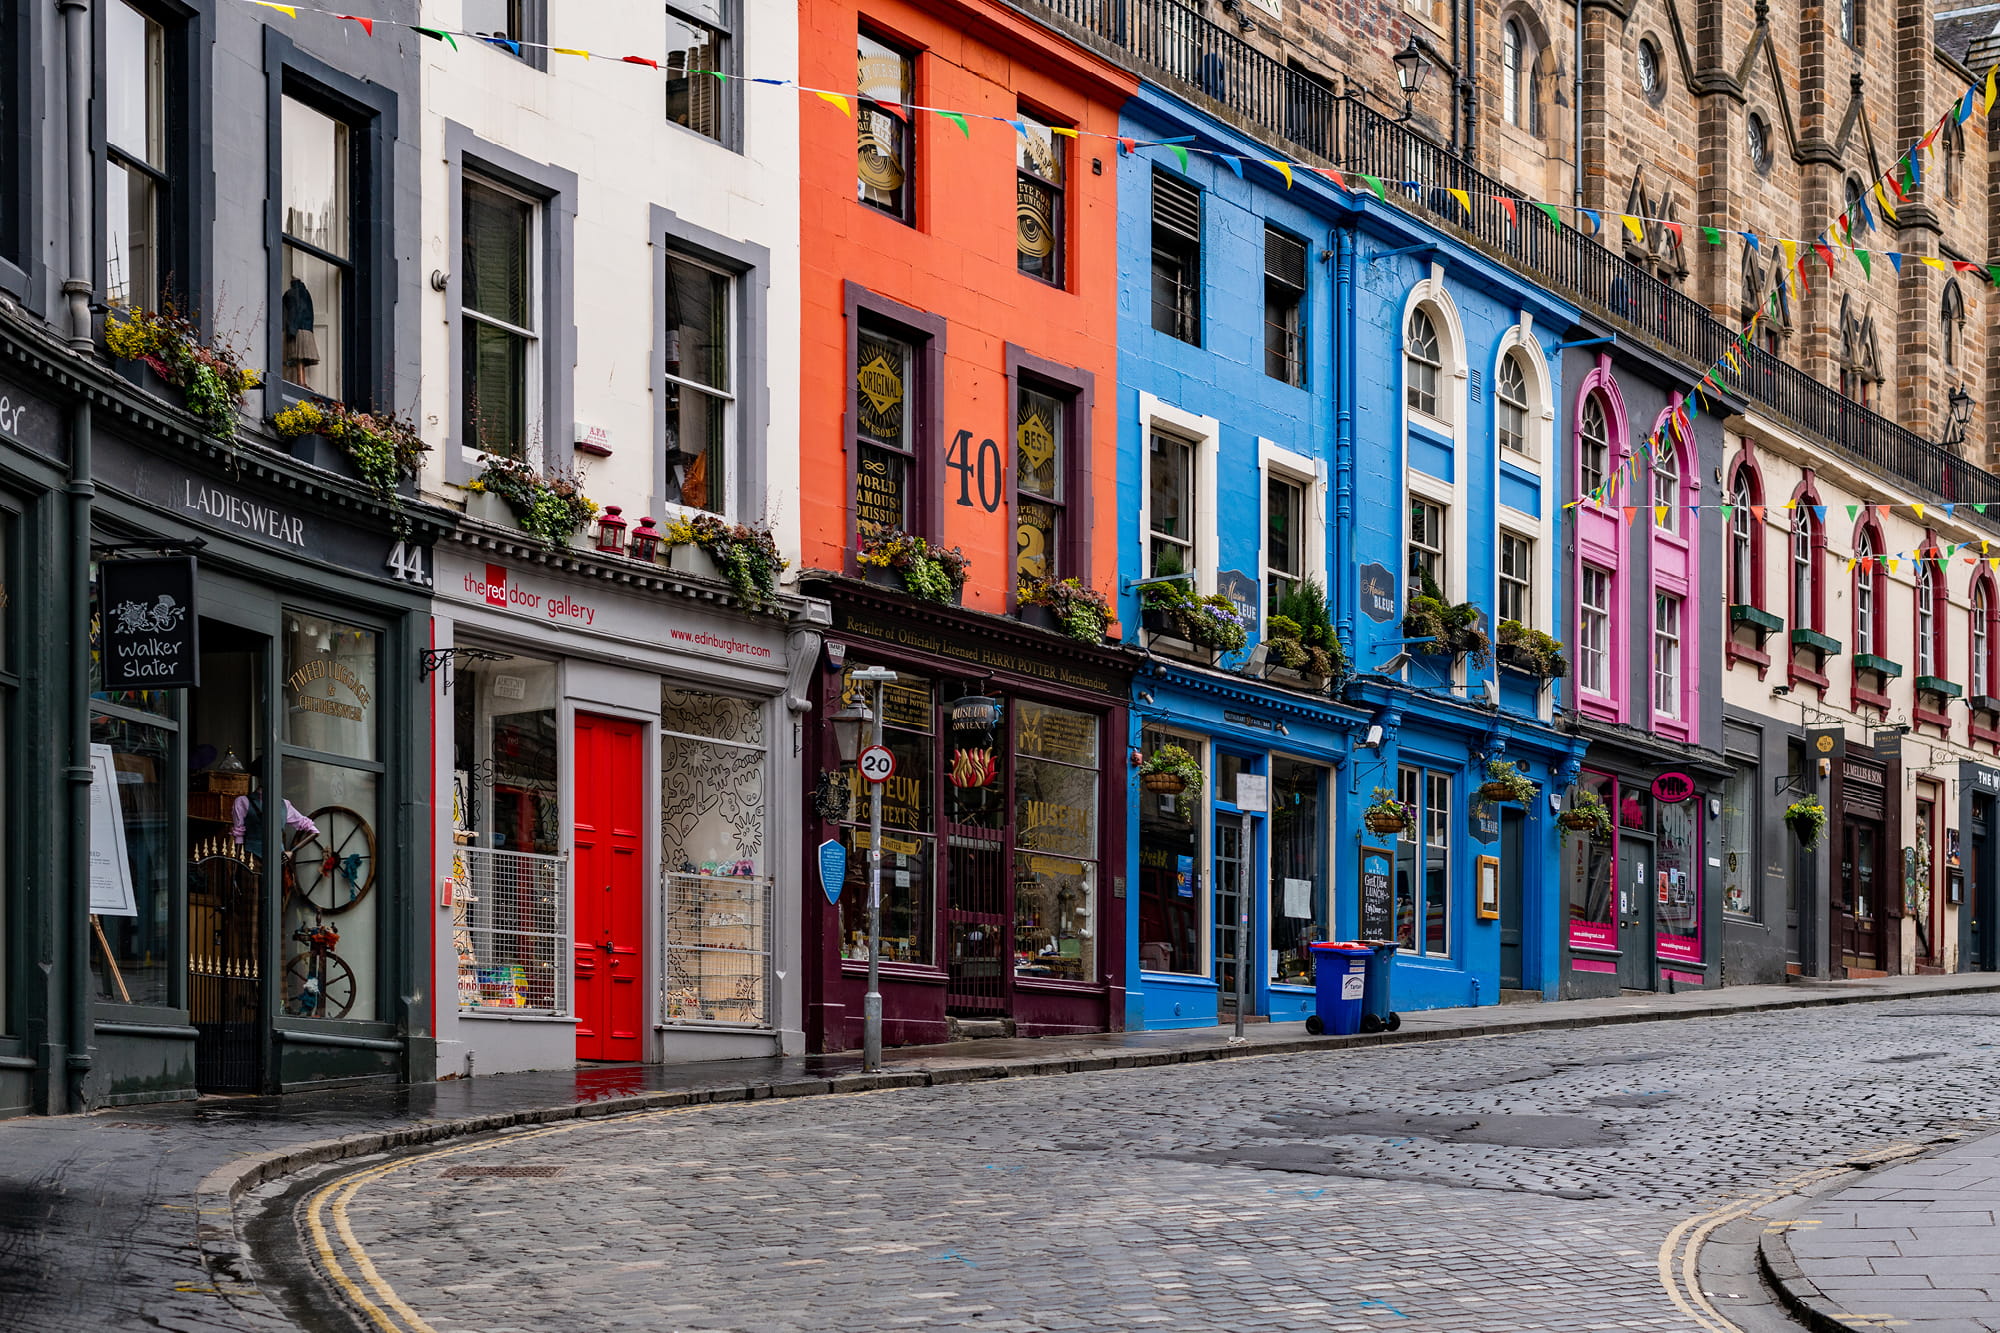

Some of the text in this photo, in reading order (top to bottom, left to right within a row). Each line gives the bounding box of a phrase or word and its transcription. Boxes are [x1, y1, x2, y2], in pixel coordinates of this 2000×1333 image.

[1018, 183, 1034, 195] EYE
[863, 370, 900, 398] ORIGINAL
[0, 396, 26, 436] er
[1023, 428, 1048, 452] BEST
[946, 429, 1002, 513] 40
[857, 490, 897, 510] AMOUS
[185, 479, 305, 547] LADIESWEAR
[464, 574, 595, 626] the red door gallery
[1374, 595, 1395, 614] BLEUE
[118, 638, 182, 657] walker
[670, 628, 771, 658] www.edinburghart.com
[846, 615, 1110, 692] Retailer of Officially Licensed HARRY POTTER Merchandise
[289, 659, 325, 692] TWEED
[327, 684, 337, 697] &
[952, 706, 988, 721] MUSEUM
[952, 721, 987, 731] CONTEXT
[864, 755, 890, 773] 20
[1871, 770, 1882, 785] SON
[1977, 770, 1992, 787] THE
[862, 802, 907, 825] CTEXT
[1027, 799, 1088, 839] MUSEUM
